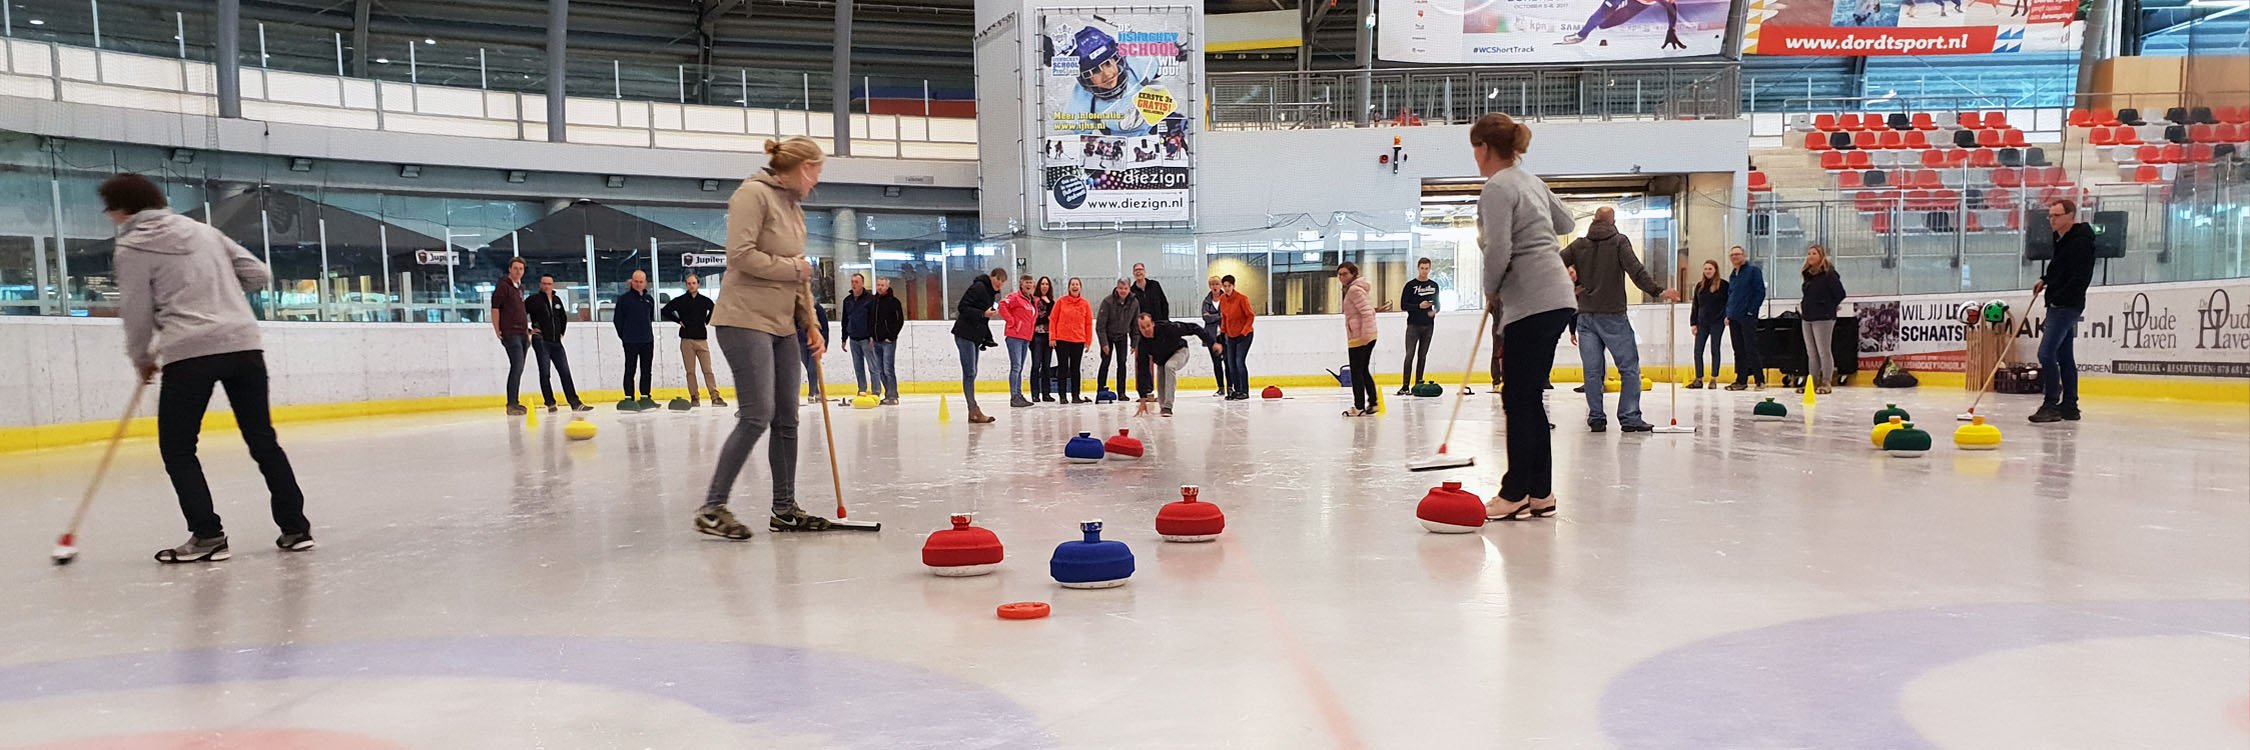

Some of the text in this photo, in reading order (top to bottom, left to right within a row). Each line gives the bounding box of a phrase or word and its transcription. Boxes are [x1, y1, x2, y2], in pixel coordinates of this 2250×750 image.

[1529, 20, 1547, 32] kpn
[1118, 43, 1179, 56] SCHOOL
[1473, 45, 1535, 54] #WCShortTrack
[1785, 33, 1969, 53] www.dordtsport.nl
[1138, 92, 1164, 102] EERSTE
[1137, 99, 1171, 112] GRATIS!
[1054, 111, 1075, 120] Meer
[1123, 168, 1186, 187] diezign
[1087, 198, 1184, 210] www.diezign.nl
[695, 255, 726, 264] Jupiler
[1902, 305, 1925, 321] WIL
[1928, 304, 1943, 320] JIJ
[2131, 293, 2177, 330] Oude
[2208, 289, 2250, 329] Oud
[1901, 325, 1967, 341] SCHAATS
[2121, 311, 2177, 349] Haven
[2195, 309, 2250, 349] Have
